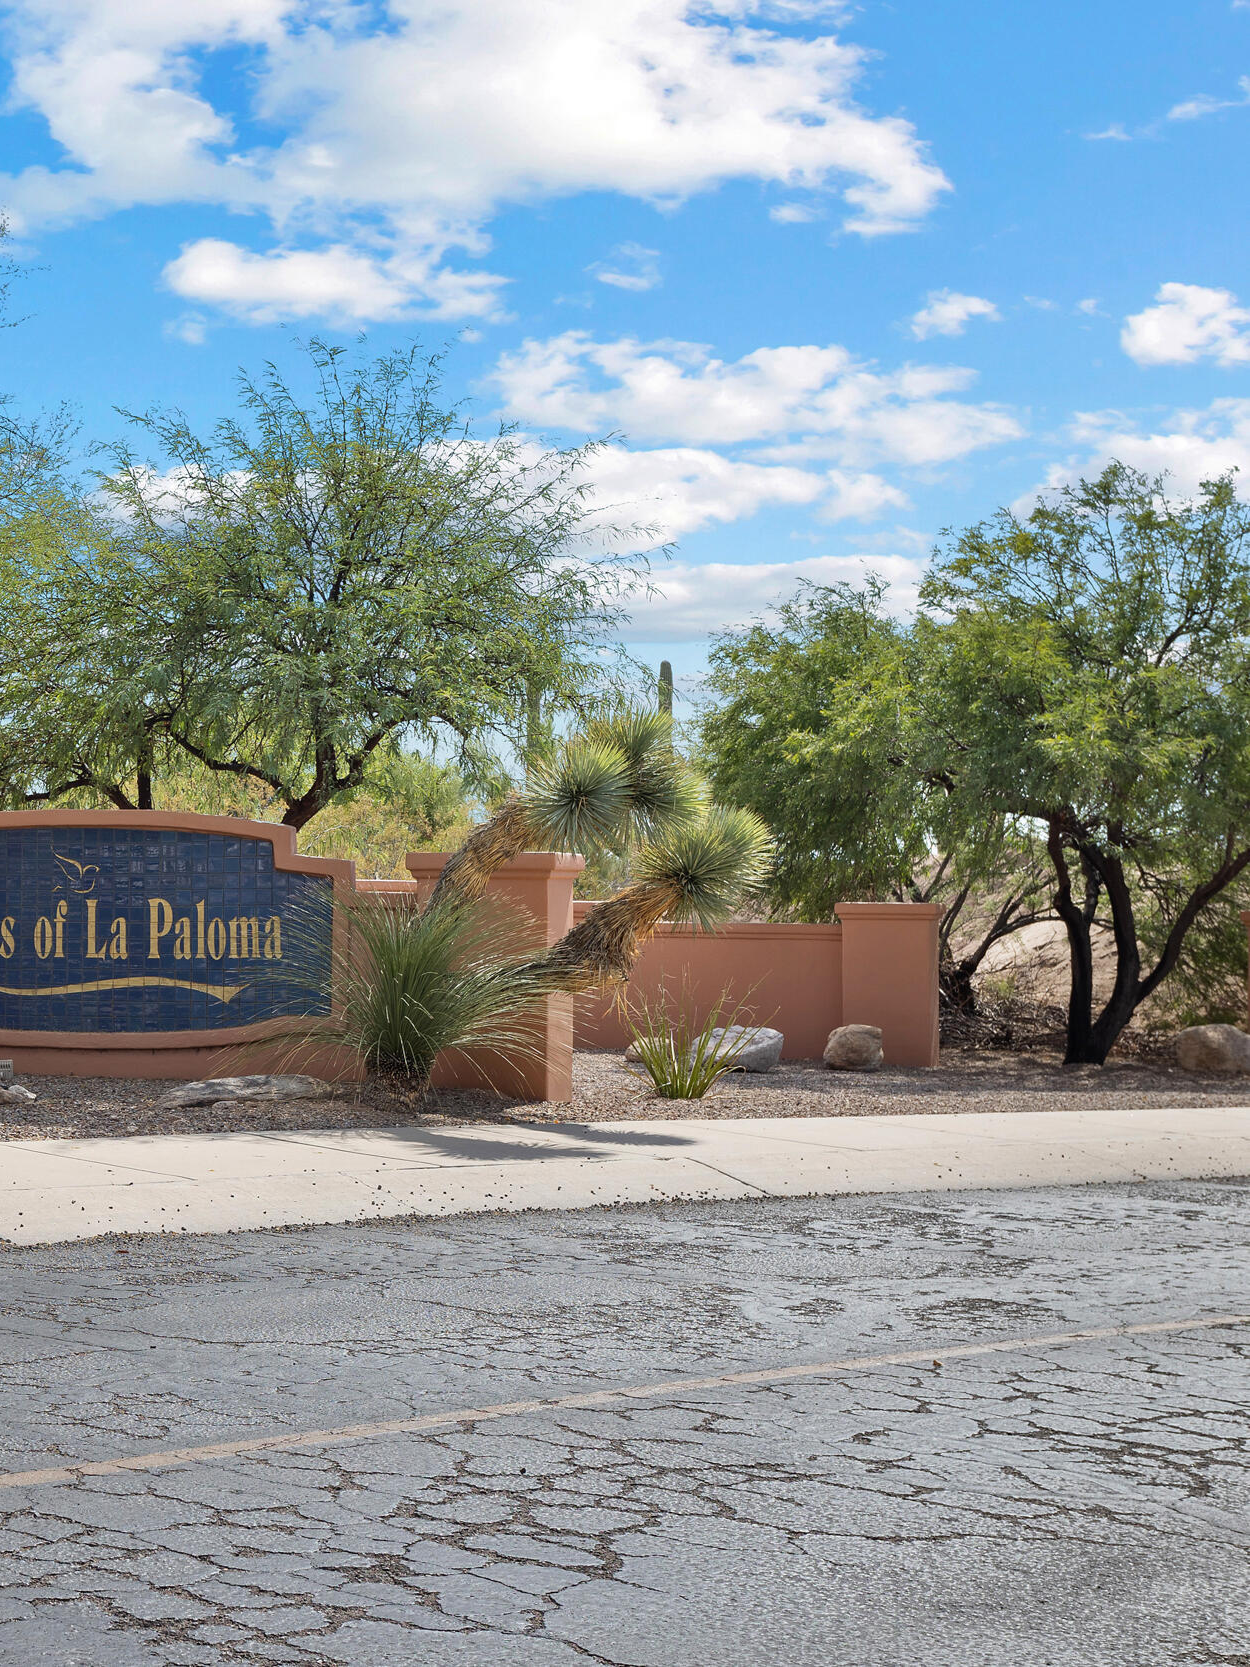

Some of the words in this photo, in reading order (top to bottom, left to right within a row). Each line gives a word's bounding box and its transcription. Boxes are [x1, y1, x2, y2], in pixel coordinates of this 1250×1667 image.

[34, 899, 69, 960] of
[85, 898, 128, 960] La
[147, 898, 283, 961] Paloma
